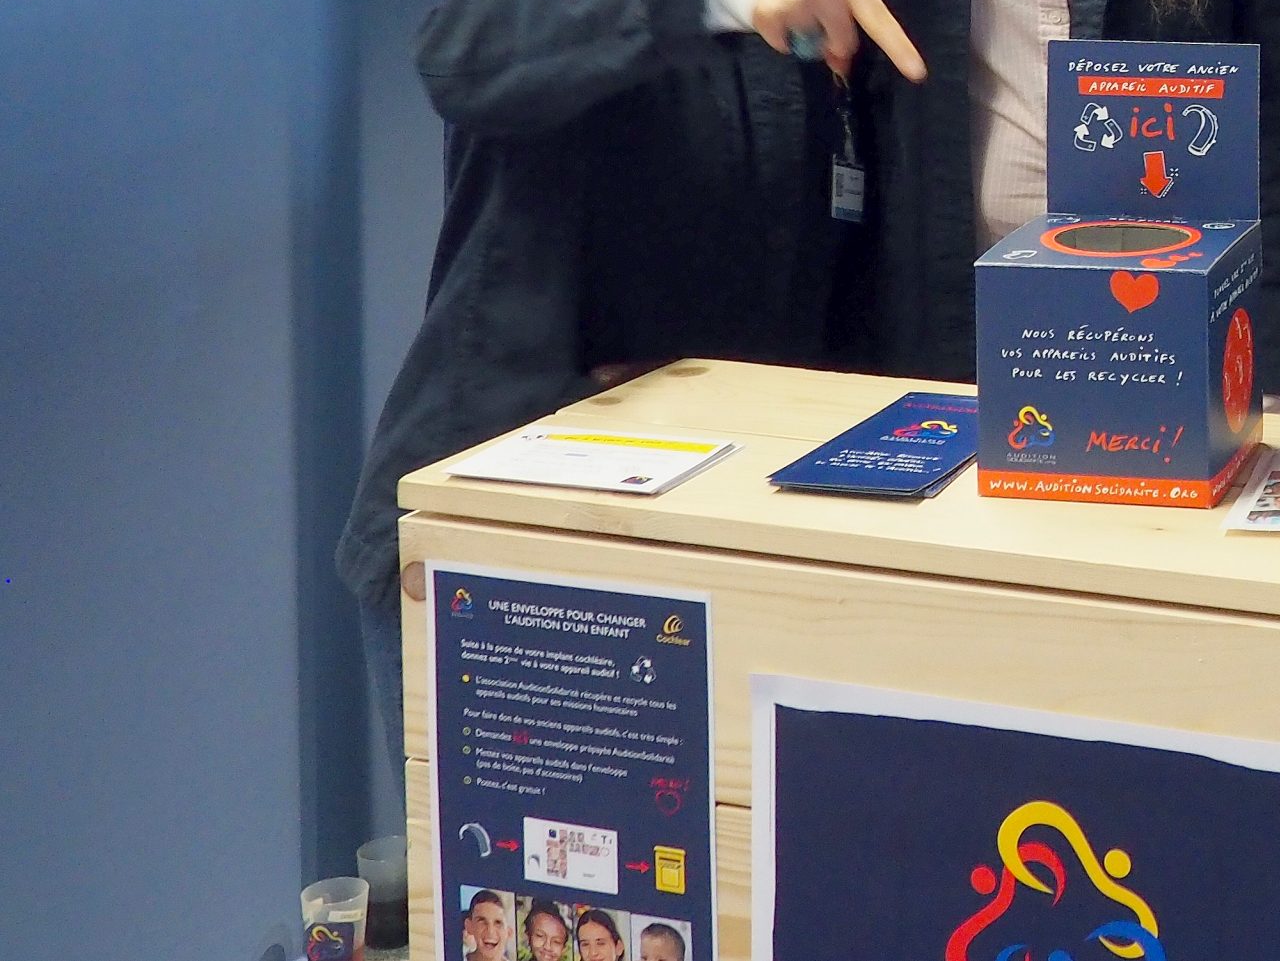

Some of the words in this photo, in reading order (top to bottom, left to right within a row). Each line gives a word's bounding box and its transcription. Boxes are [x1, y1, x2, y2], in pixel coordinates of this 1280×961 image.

[1068, 59, 1129, 73] DÉPOSEZ
[1138, 62, 1180, 74] VOTRE
[1129, 102, 1175, 141] ici
[1021, 328, 1055, 339] NOUS
[1068, 324, 1154, 342] RÉCUPÉRONS
[1001, 349, 1022, 359] VOS
[1012, 367, 1042, 378] POUR
[1056, 370, 1076, 381] LES
[1088, 371, 1166, 386] RECYCLER
[488, 600, 510, 612] UNE
[511, 603, 565, 619] ENVELOPPE
[566, 609, 595, 622] POUR
[597, 613, 647, 628] CHANGER
[504, 614, 561, 630] L'AUDITION
[563, 621, 589, 634] D'UN
[591, 625, 631, 639] ENFANT
